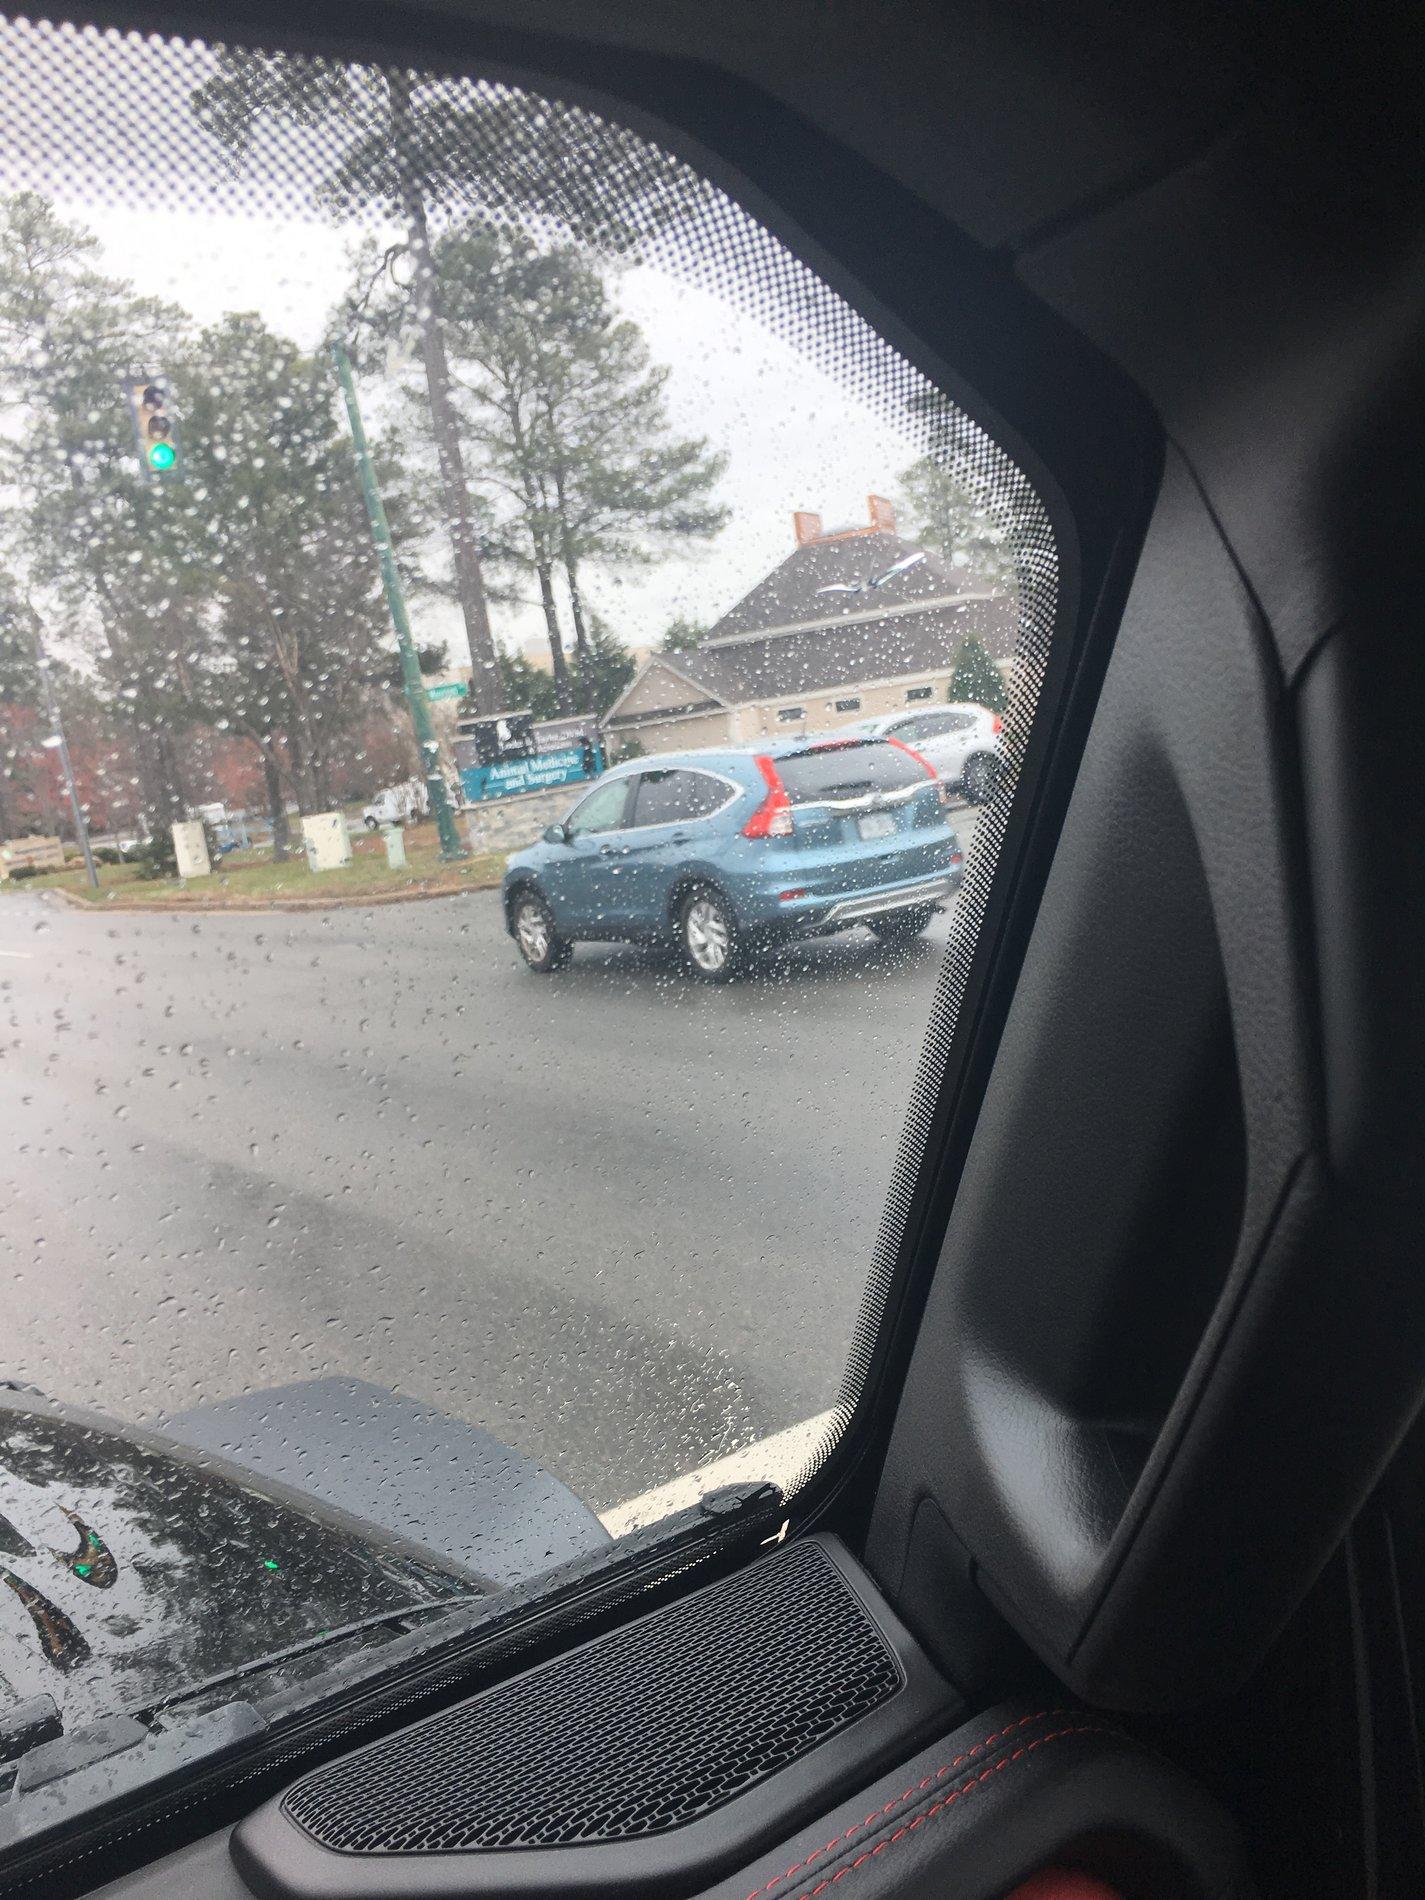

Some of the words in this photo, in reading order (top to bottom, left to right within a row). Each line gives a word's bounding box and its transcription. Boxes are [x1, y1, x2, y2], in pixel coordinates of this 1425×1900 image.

[489, 762, 529, 780] Animal
[530, 754, 579, 772] Medicine
[505, 774, 525, 789] and
[526, 769, 567, 785] Surgery
